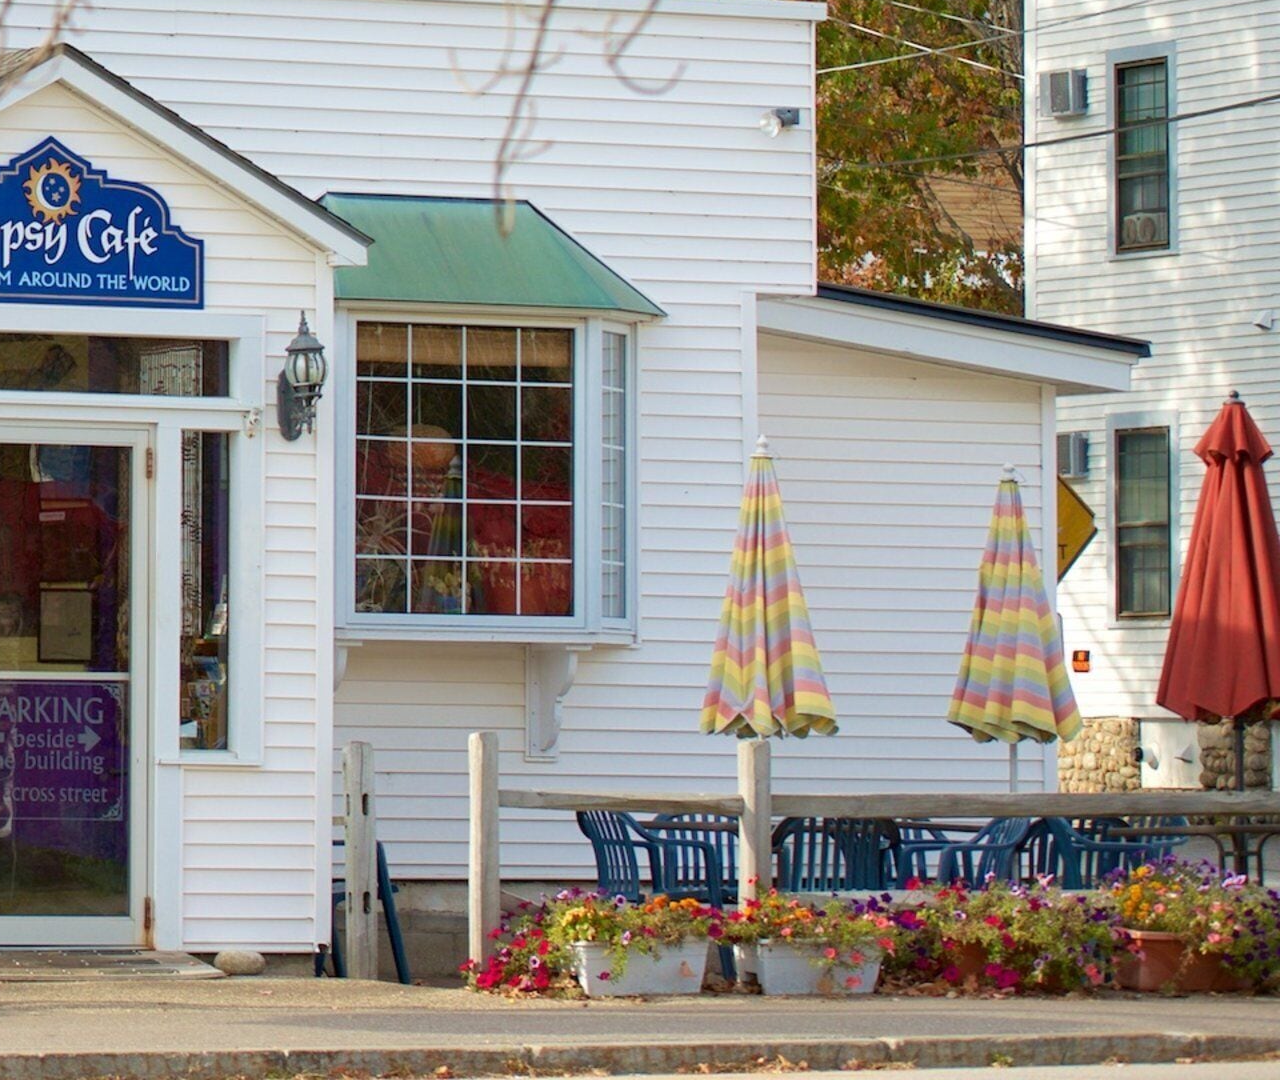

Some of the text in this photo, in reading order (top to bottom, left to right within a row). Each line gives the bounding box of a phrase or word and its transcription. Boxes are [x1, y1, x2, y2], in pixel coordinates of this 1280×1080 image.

[76, 205, 159, 280] Café
[18, 270, 92, 289] AROUND
[96, 273, 127, 291] THE
[133, 275, 191, 293] WORLD
[13, 728, 76, 750] beside
[24, 750, 106, 775] building
[58, 786, 108, 803] street
